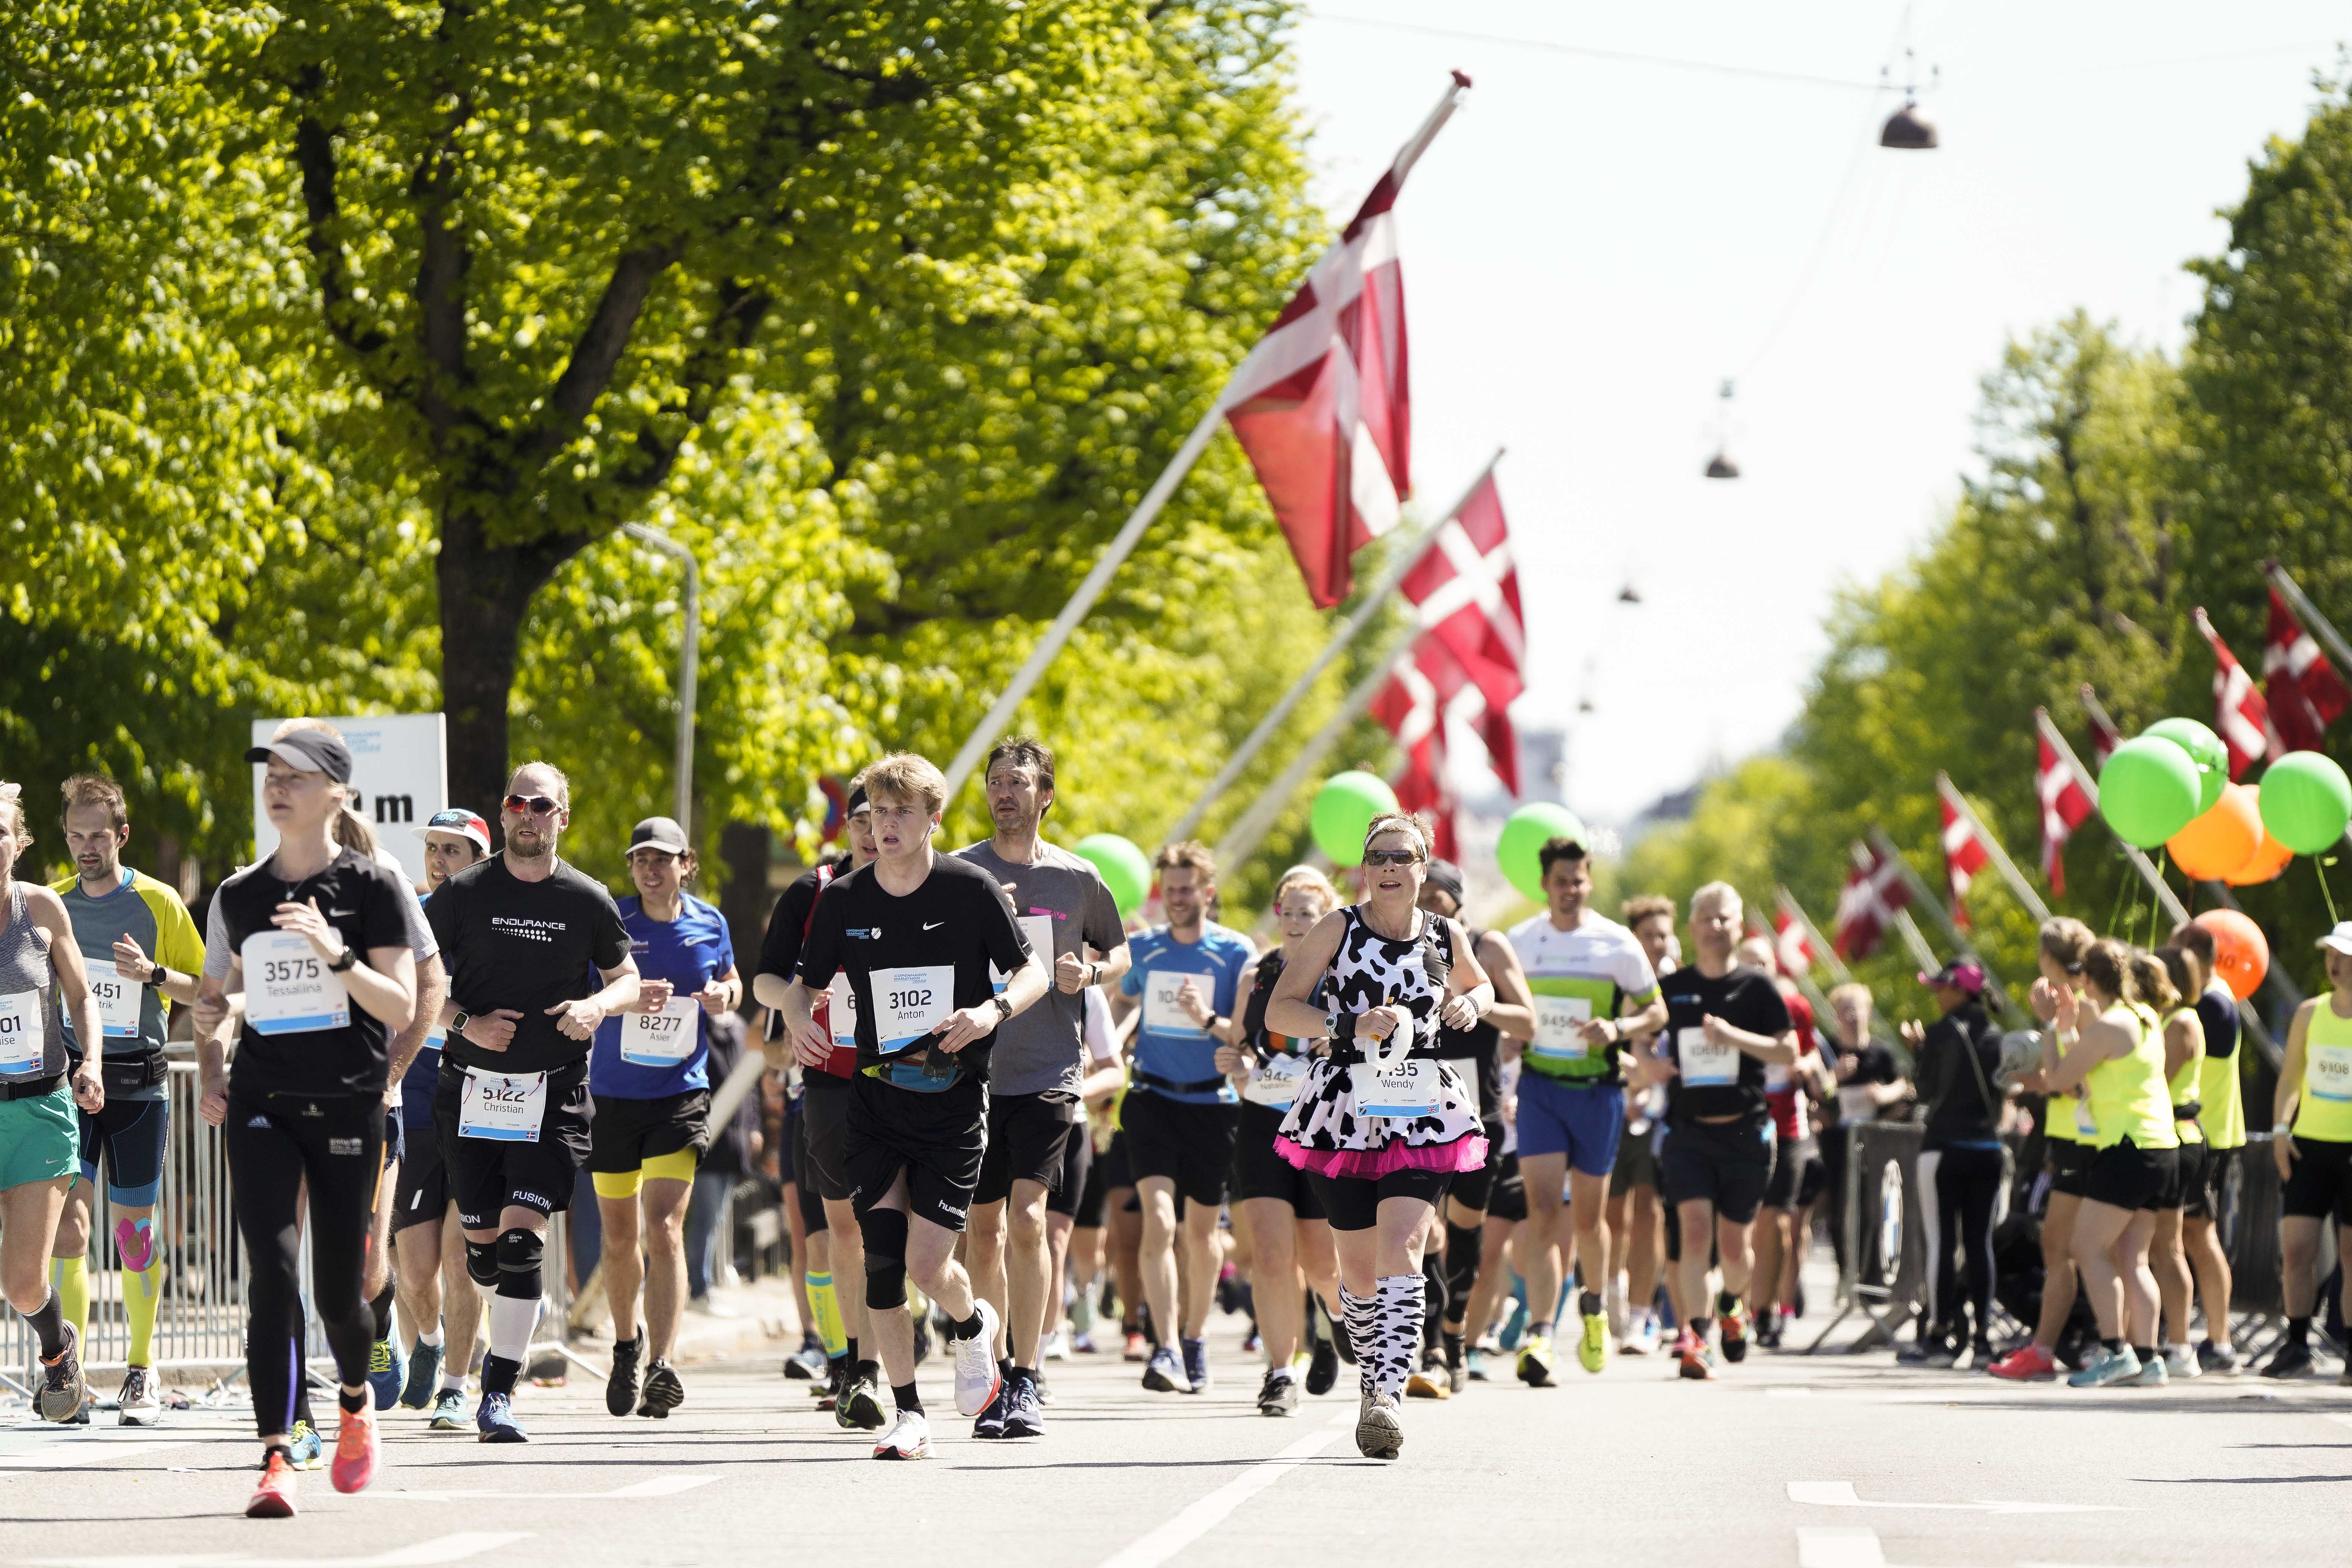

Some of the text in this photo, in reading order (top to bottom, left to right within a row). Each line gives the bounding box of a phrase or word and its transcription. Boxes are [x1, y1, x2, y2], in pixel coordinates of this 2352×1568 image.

[492, 917, 566, 930] ENDURANCE
[265, 958, 320, 982] 3575
[88, 980, 121, 999] 451
[889, 989, 932, 1009] 3102
[897, 1010, 924, 1020] Anton
[640, 1015, 681, 1032] 8277
[649, 1032, 671, 1042] Asier
[1381, 1079, 1414, 1090] Wendy
[482, 1087, 525, 1102] 5122
[484, 1102, 523, 1114] Christian
[513, 1191, 551, 1210] FUSION
[939, 1199, 966, 1219] hummel
[459, 1213, 481, 1223] SION
